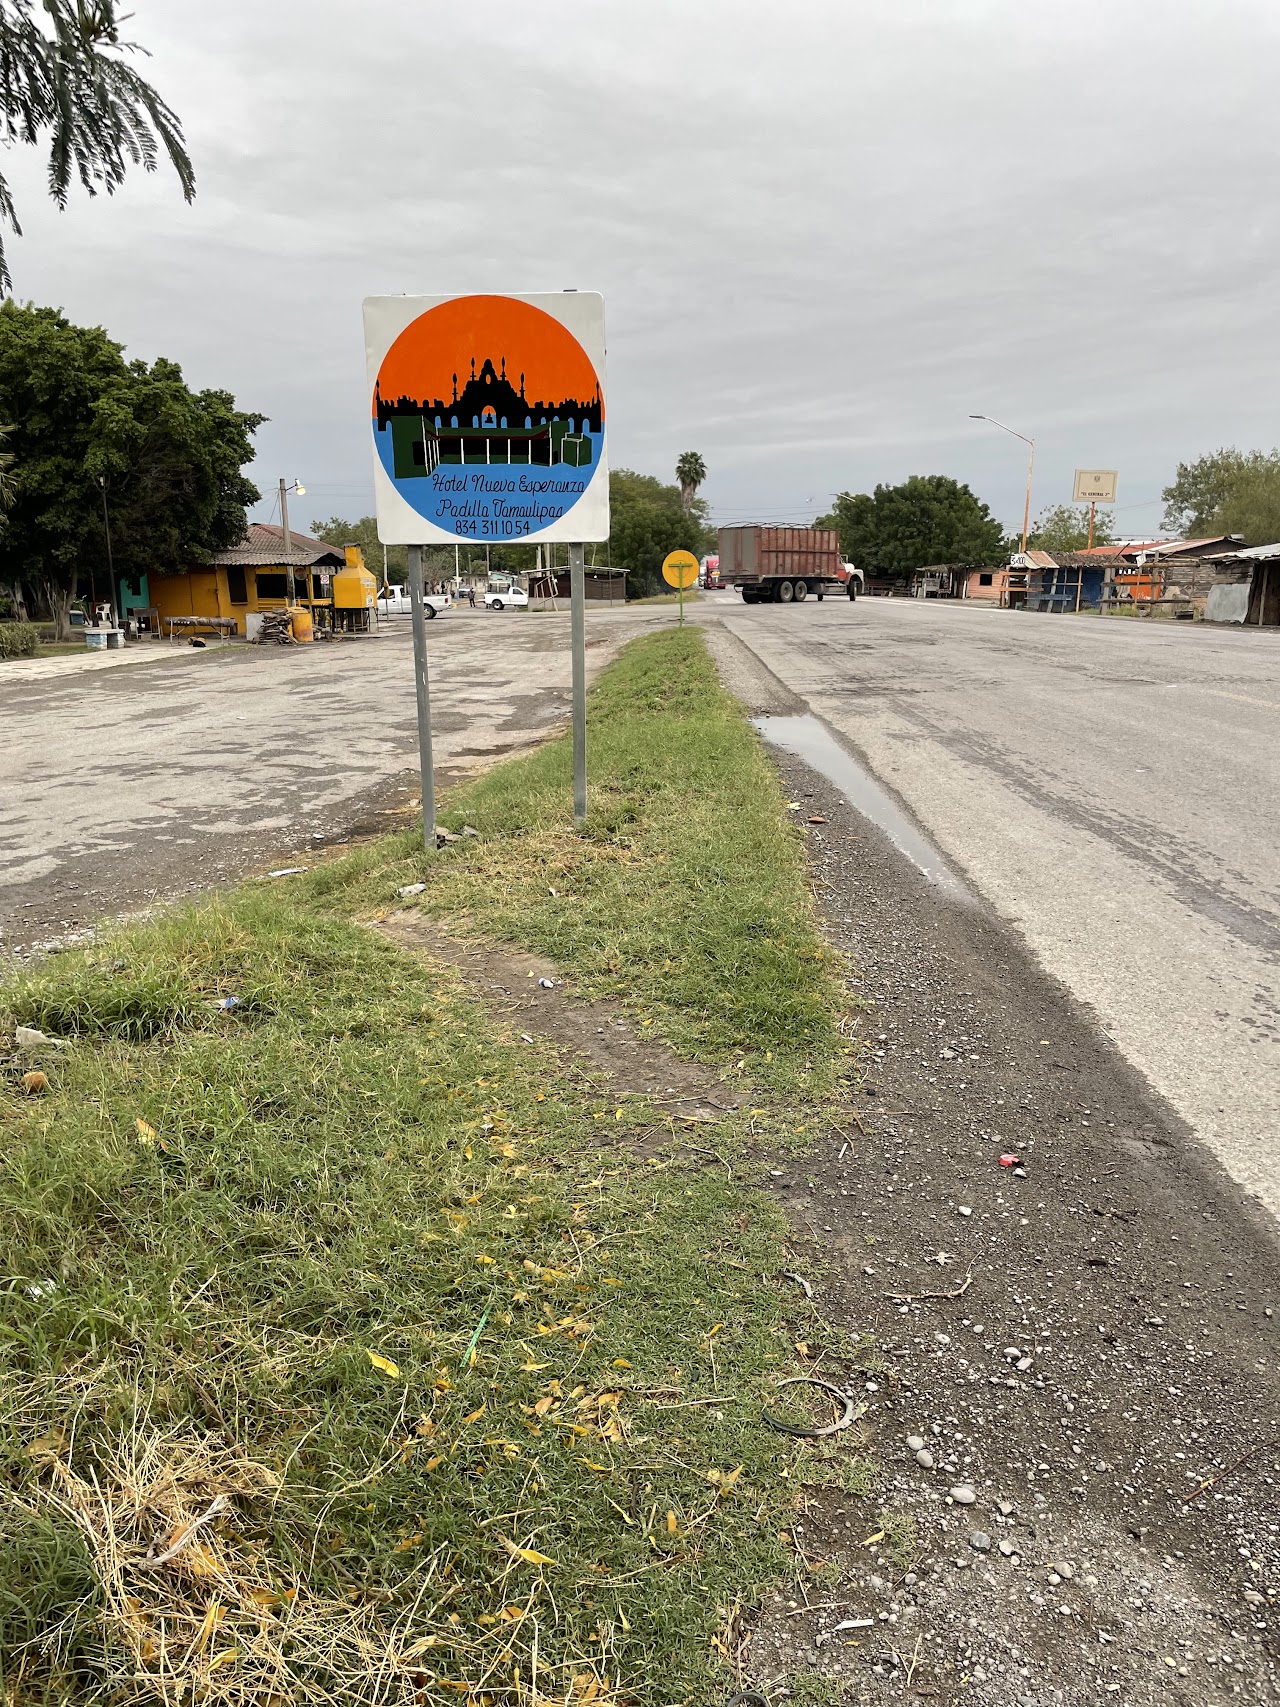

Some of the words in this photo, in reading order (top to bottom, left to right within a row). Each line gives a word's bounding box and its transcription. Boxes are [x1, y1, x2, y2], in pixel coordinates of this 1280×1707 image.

[432, 473, 467, 492] Hotel
[471, 474, 516, 492] Nueva
[518, 474, 585, 497] Esperanza
[435, 499, 490, 518] Padilla
[492, 498, 564, 524] Tamaulipas
[455, 520, 477, 535] 834
